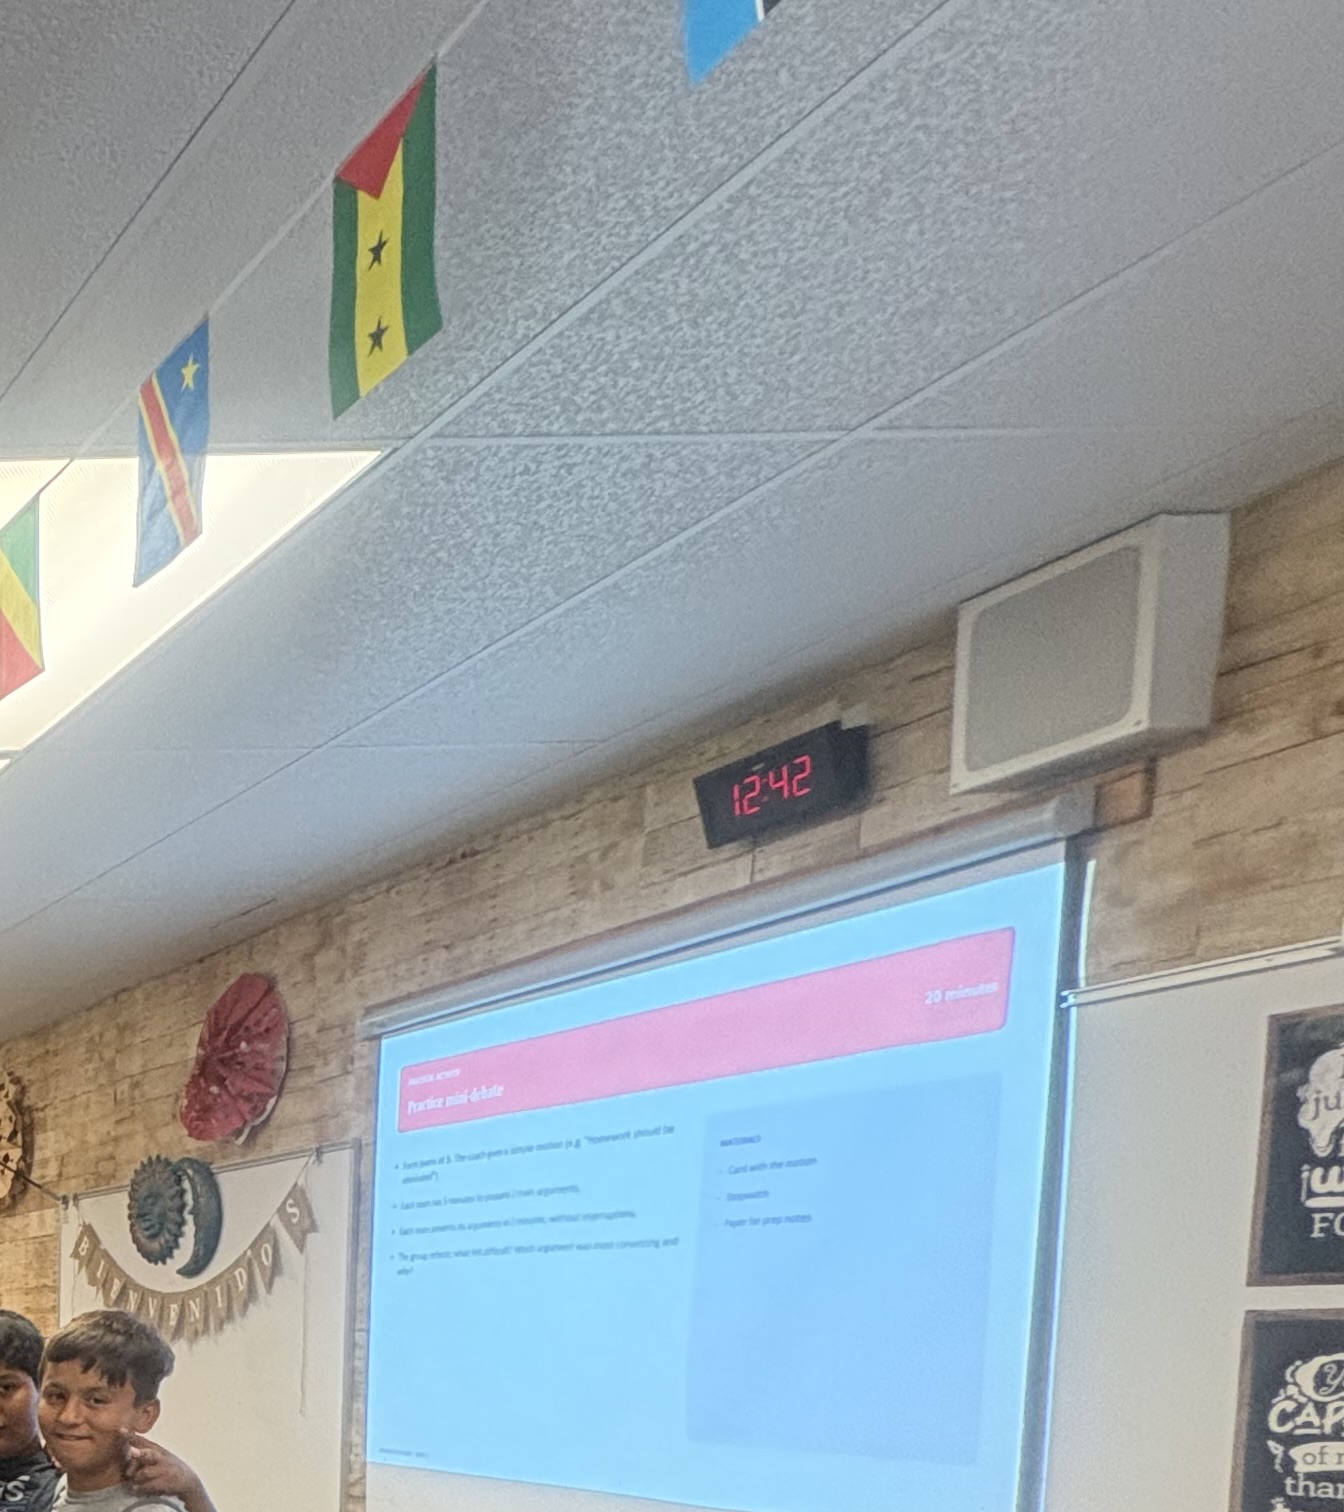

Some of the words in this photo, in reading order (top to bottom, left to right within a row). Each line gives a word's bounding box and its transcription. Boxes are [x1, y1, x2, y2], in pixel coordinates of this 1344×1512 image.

[732, 755, 812, 817] 12:42
[407, 1097, 445, 1115] Practice
[445, 1084, 504, 1107] mini-debate
[78, 1198, 300, 1326] BIENVENIDOS
[1302, 1445, 1329, 1466] of
